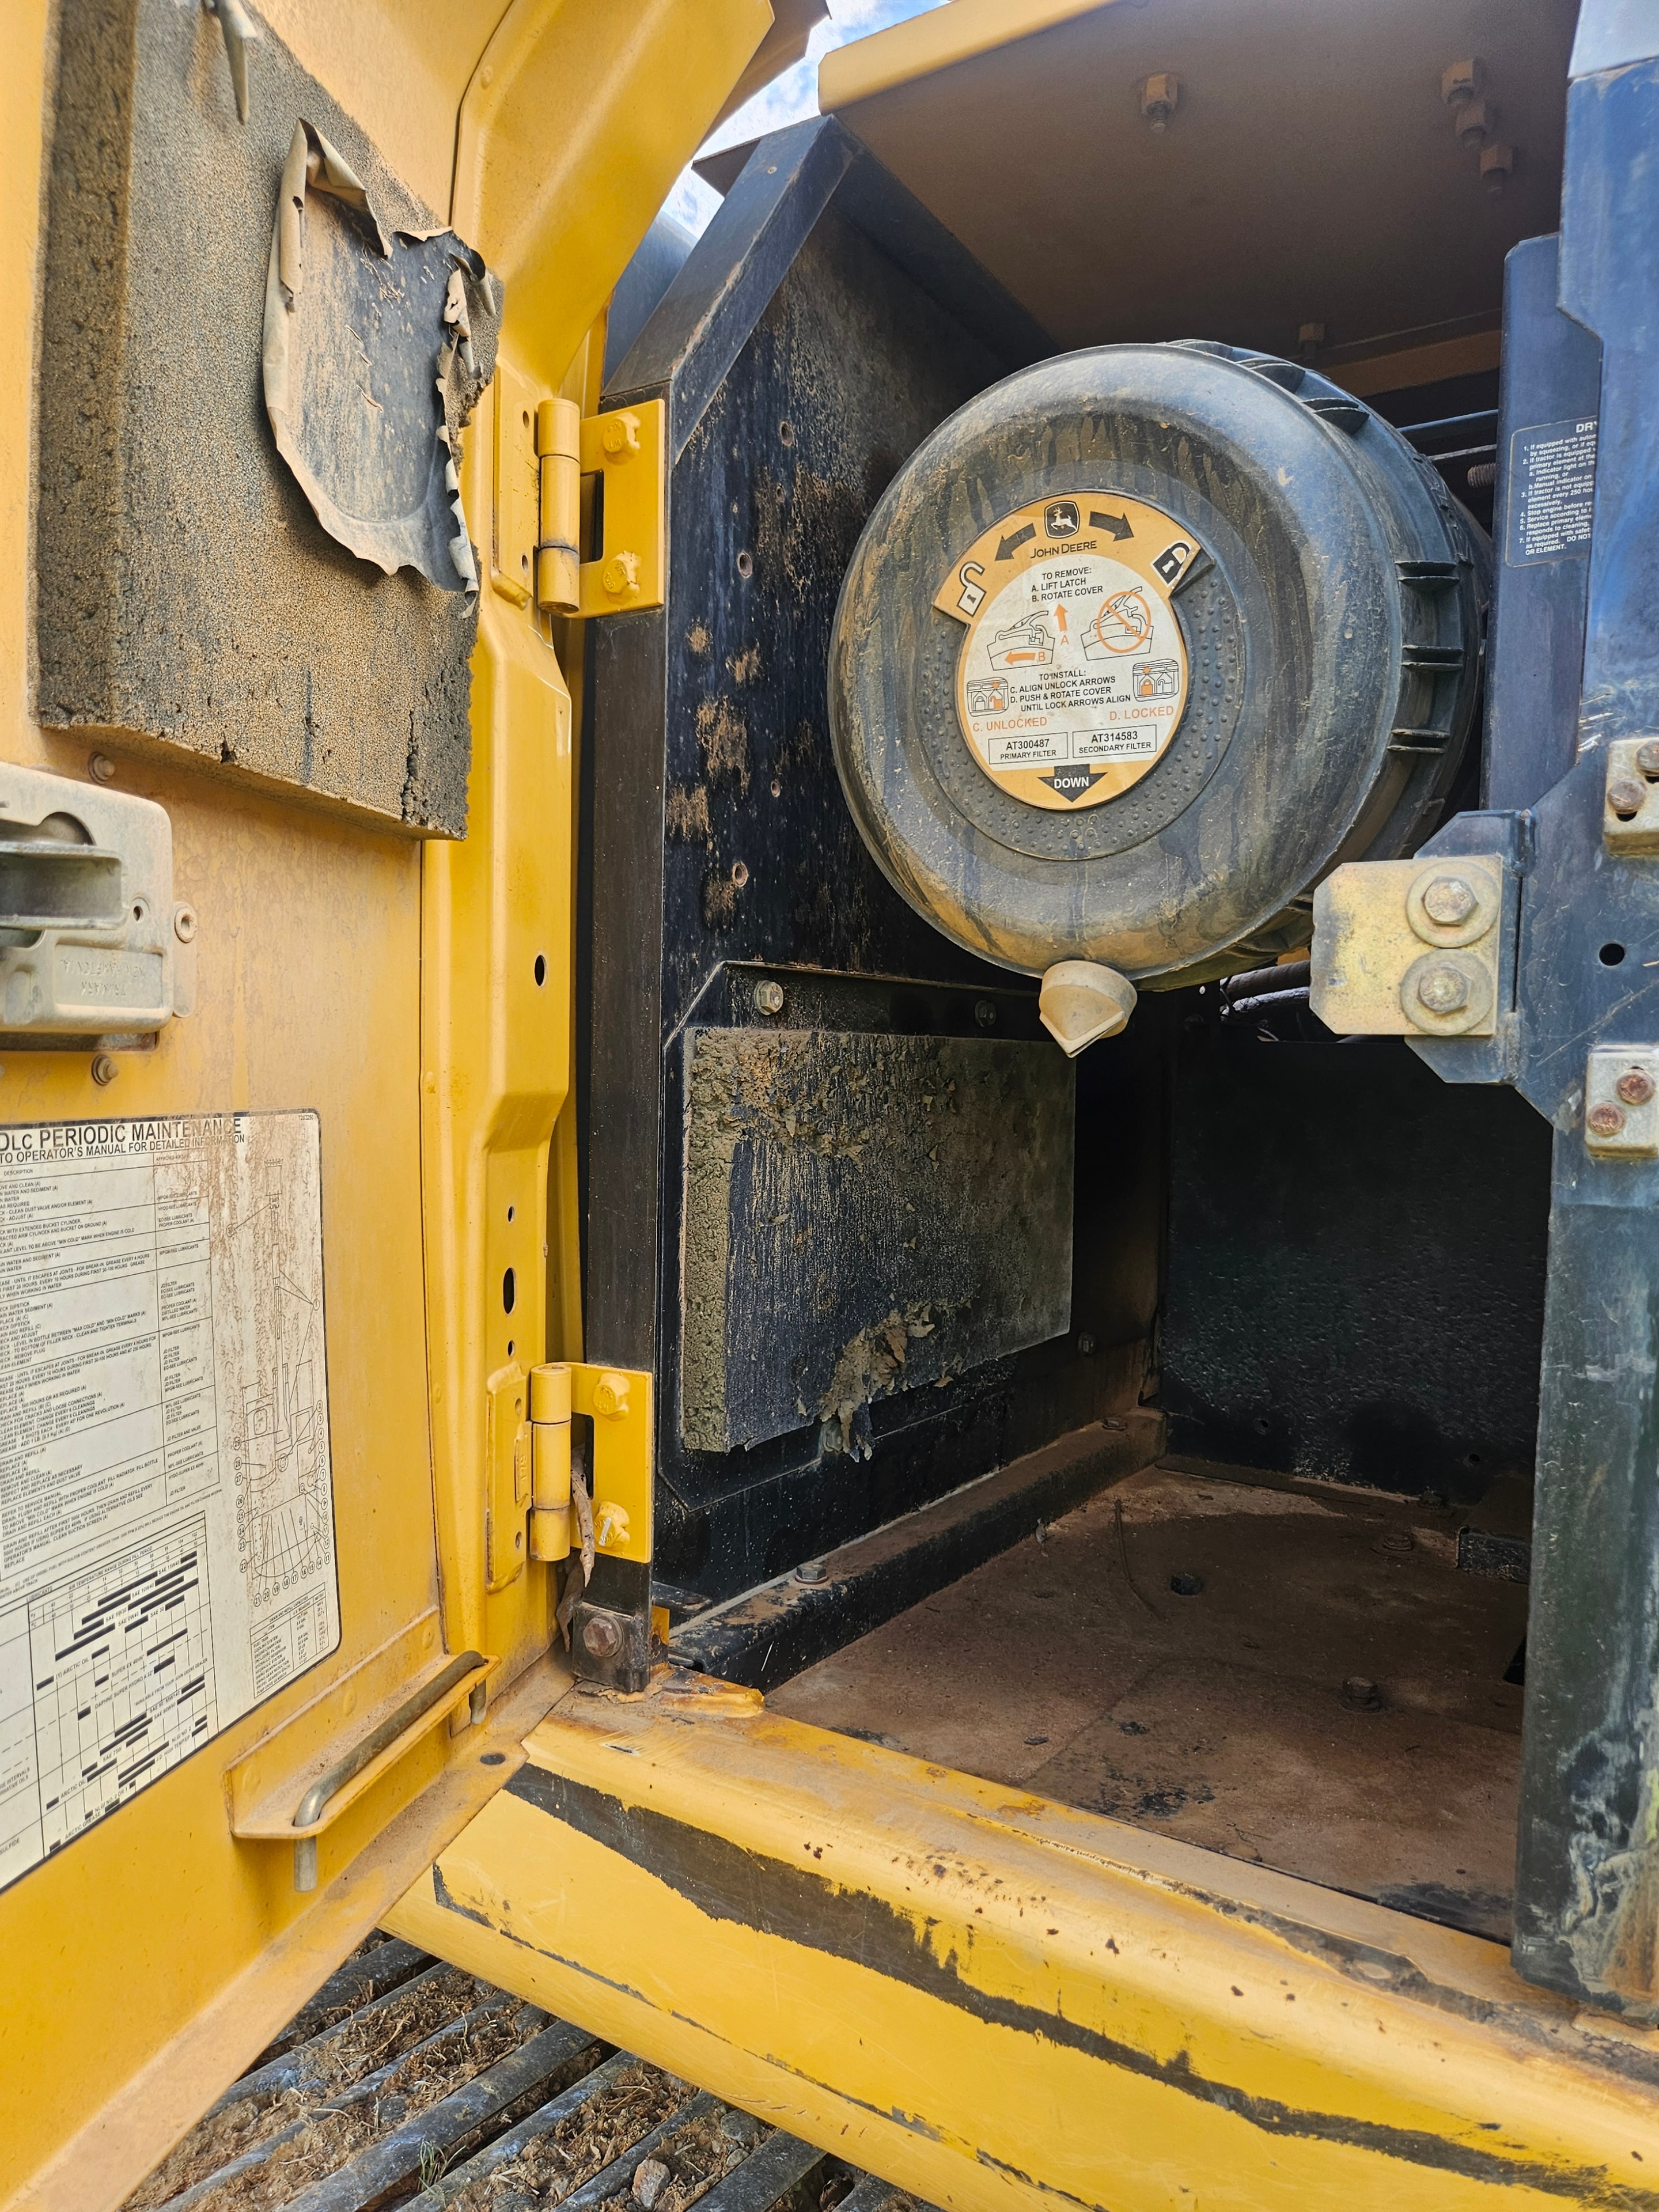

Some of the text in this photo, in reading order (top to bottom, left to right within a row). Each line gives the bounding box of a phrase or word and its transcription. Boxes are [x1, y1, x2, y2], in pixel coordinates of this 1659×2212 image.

[1536, 440, 1563, 449] equipped
[1563, 448, 1590, 457] equipped
[1529, 461, 1551, 471] primary
[1553, 457, 1576, 465] element
[1536, 466, 1562, 475] Indicator
[1556, 475, 1582, 484] indicator
[1535, 487, 1553, 495] tractor
[1528, 494, 1551, 503] element
[1528, 499, 1562, 509] excessively.
[1527, 514, 1548, 522] Service
[1550, 509, 1579, 519] according
[1527, 521, 1550, 529] Replace
[1551, 517, 1573, 526] primary
[1527, 527, 1553, 536] responds
[1563, 521, 1589, 530] cleaning.
[1532, 532, 1559, 541] equipped
[1031, 540, 1097, 558] JOHN DEERE
[1534, 539, 1560, 547] required.
[1536, 544, 1566, 553] ELEMENT.
[1055, 567, 1092, 578] REMOVE:
[1041, 582, 1058, 590] LIFT
[1060, 578, 1086, 588] LATCH
[1041, 590, 1072, 601] ROTATE
[1075, 586, 1103, 596] COVER
[1061, 635, 1069, 645] A
[1039, 652, 1045, 661] B
[1020, 683, 1043, 693] ALIGN
[1045, 680, 1077, 690] UNLOCK
[1080, 676, 1116, 687] ARROWS
[1020, 694, 1041, 702] PUSH
[1051, 690, 1080, 699] ROTATE
[1083, 687, 1111, 696] COVER
[1046, 701, 1066, 710] LOCK
[1068, 698, 1104, 707] ARROWS
[1106, 695, 1131, 703] ALIGN
[1109, 706, 1173, 720] D. LOCKED
[973, 717, 1047, 732] C. UNLOCKED
[1091, 731, 1138, 743] AT314583
[1006, 738, 1050, 750] AT300487
[1079, 744, 1124, 753] SECONDARY
[1001, 752, 1031, 760] PRIMARY
[1054, 777, 1089, 789] DOWN
[40, 1124, 126, 1149] PERIODIC
[0, 1153, 13, 1164] TO
[17, 1146, 83, 1162] OPERATOR'S
[86, 1142, 126, 1156] MANUAL
[129, 1142, 147, 1152] FOR
[150, 1138, 190, 1150] DETAILED
[264, 1591, 270, 1599] 20
